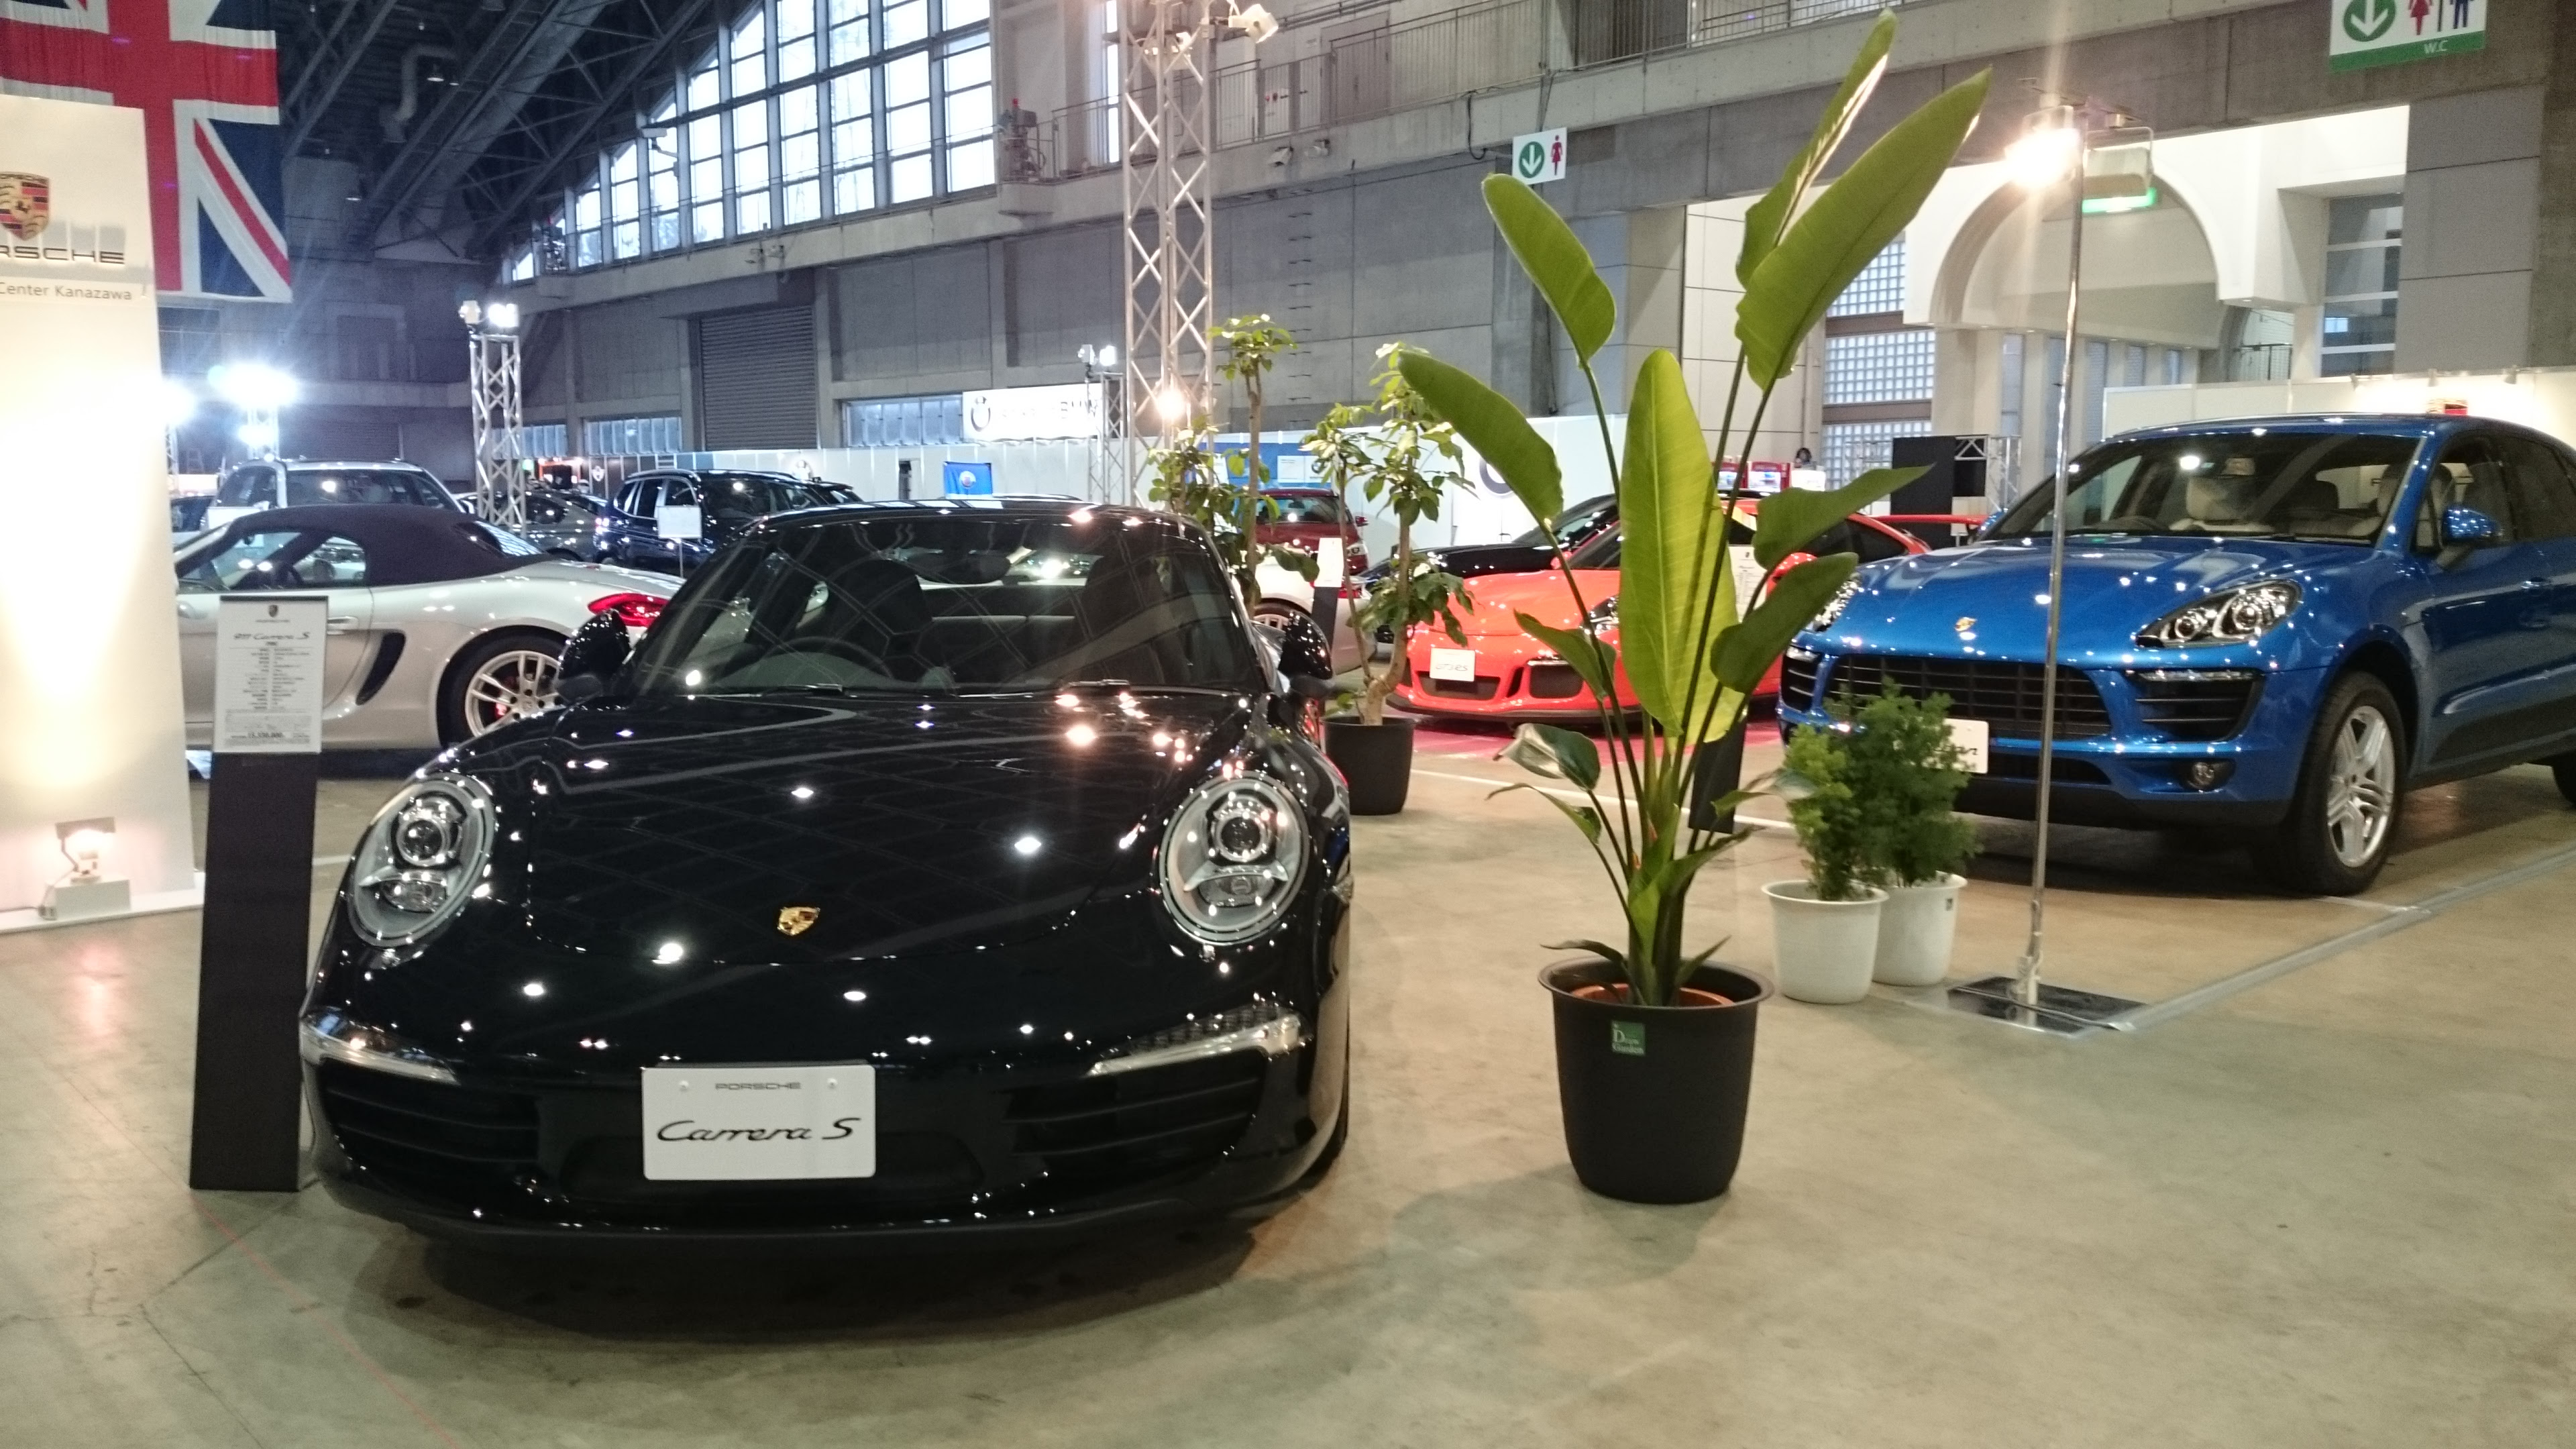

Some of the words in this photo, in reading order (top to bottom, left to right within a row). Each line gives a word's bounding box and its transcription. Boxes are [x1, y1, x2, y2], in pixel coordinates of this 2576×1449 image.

[55, 285, 132, 301] Kanazawa
[715, 1082, 802, 1090] PORSCHE
[657, 1120, 812, 1142] Carrera
[822, 1118, 862, 1140] S
